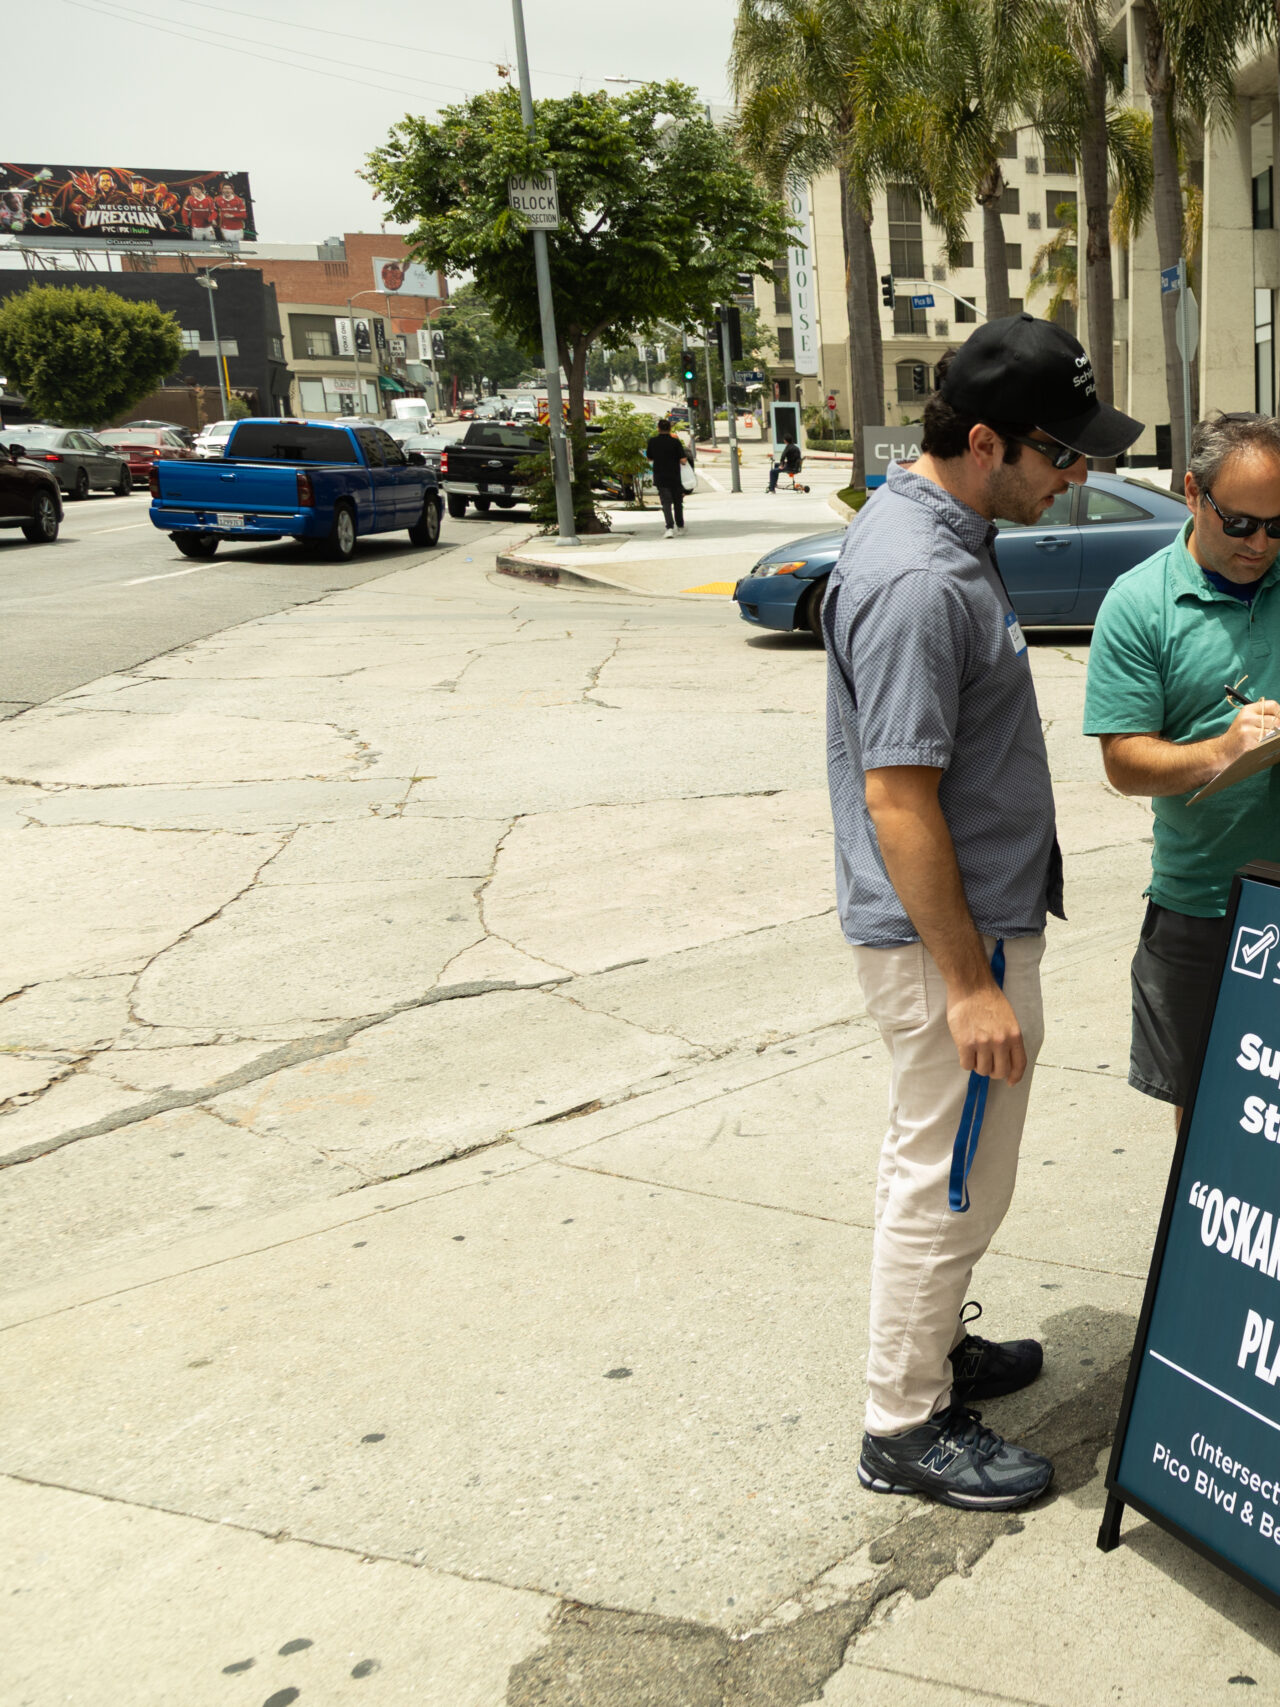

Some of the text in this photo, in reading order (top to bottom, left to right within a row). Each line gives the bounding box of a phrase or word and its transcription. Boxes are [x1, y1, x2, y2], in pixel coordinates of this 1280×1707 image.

[511, 177, 552, 190] DO NOT
[513, 196, 555, 210] BLOCK
[84, 210, 166, 231] WREXHAM
[794, 249, 811, 352] HOUSE
[1152, 1442, 1190, 1483] Pico
[1194, 1469, 1237, 1514] Blvd
[1240, 1501, 1254, 1526] &
